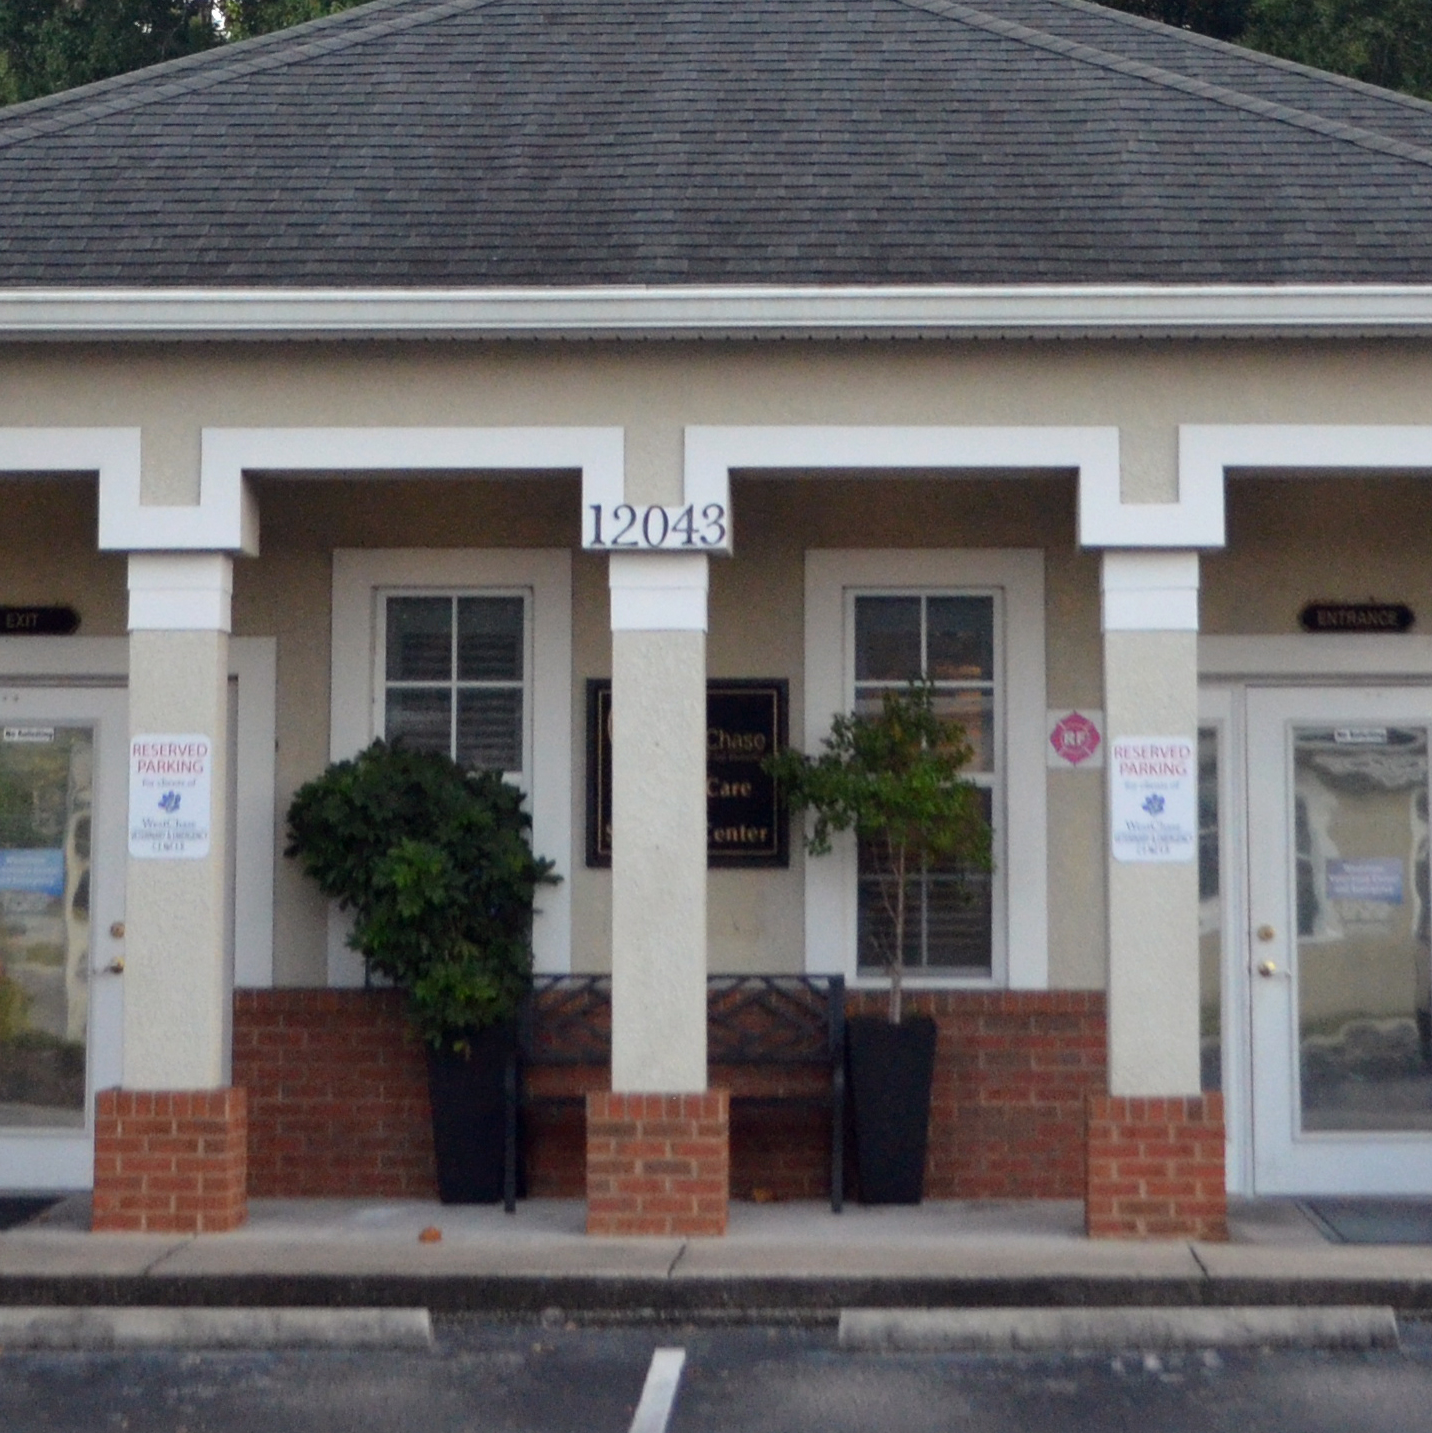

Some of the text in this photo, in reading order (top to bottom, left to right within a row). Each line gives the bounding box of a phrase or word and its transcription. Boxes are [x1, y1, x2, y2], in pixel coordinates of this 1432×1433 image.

[588, 503, 727, 548] 12043
[6, 613, 38, 628] EXIT
[1316, 610, 1398, 627] ENTRANCE
[1064, 730, 1087, 746] RF
[132, 743, 208, 757] RESERVED
[1114, 745, 1191, 759] RESERVED
[137, 759, 204, 774] PARKING
[1119, 761, 1187, 776] PARKING
[706, 776, 753, 797] Care
[707, 823, 768, 843] enter
